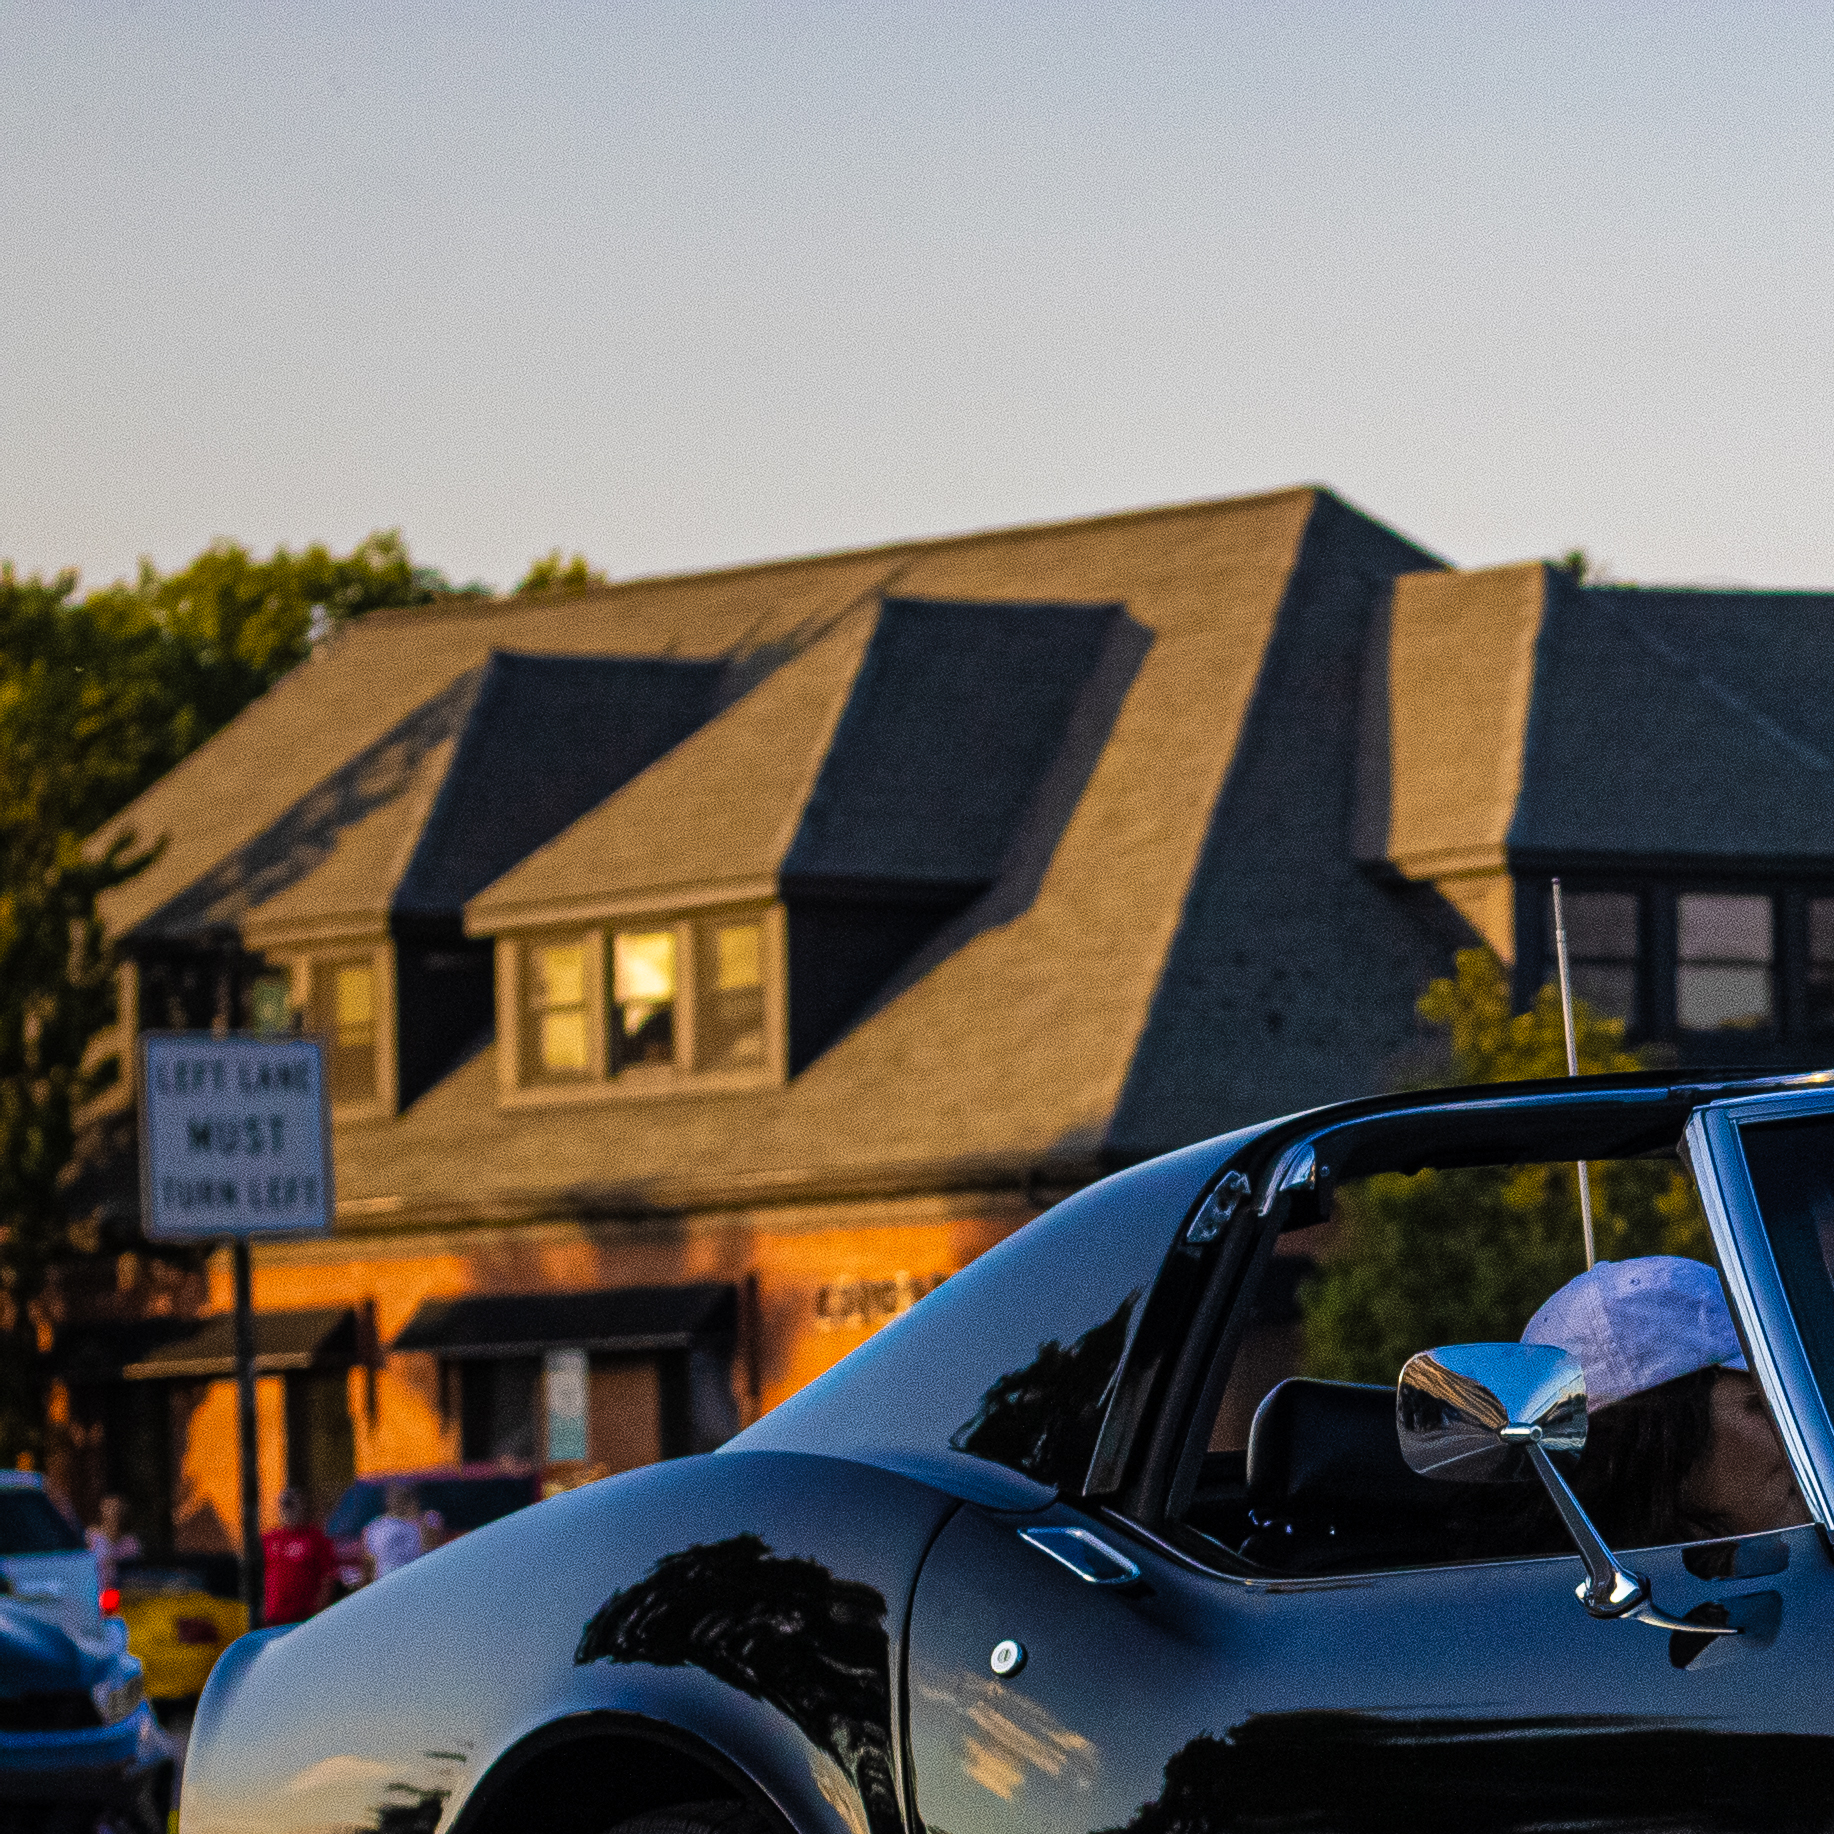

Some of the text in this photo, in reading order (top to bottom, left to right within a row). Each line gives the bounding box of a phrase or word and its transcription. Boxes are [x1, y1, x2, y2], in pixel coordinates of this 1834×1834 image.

[156, 1058, 311, 1093] LEFT LANE
[187, 1114, 286, 1155] MUST
[163, 1175, 318, 1211] TURN LEFT
